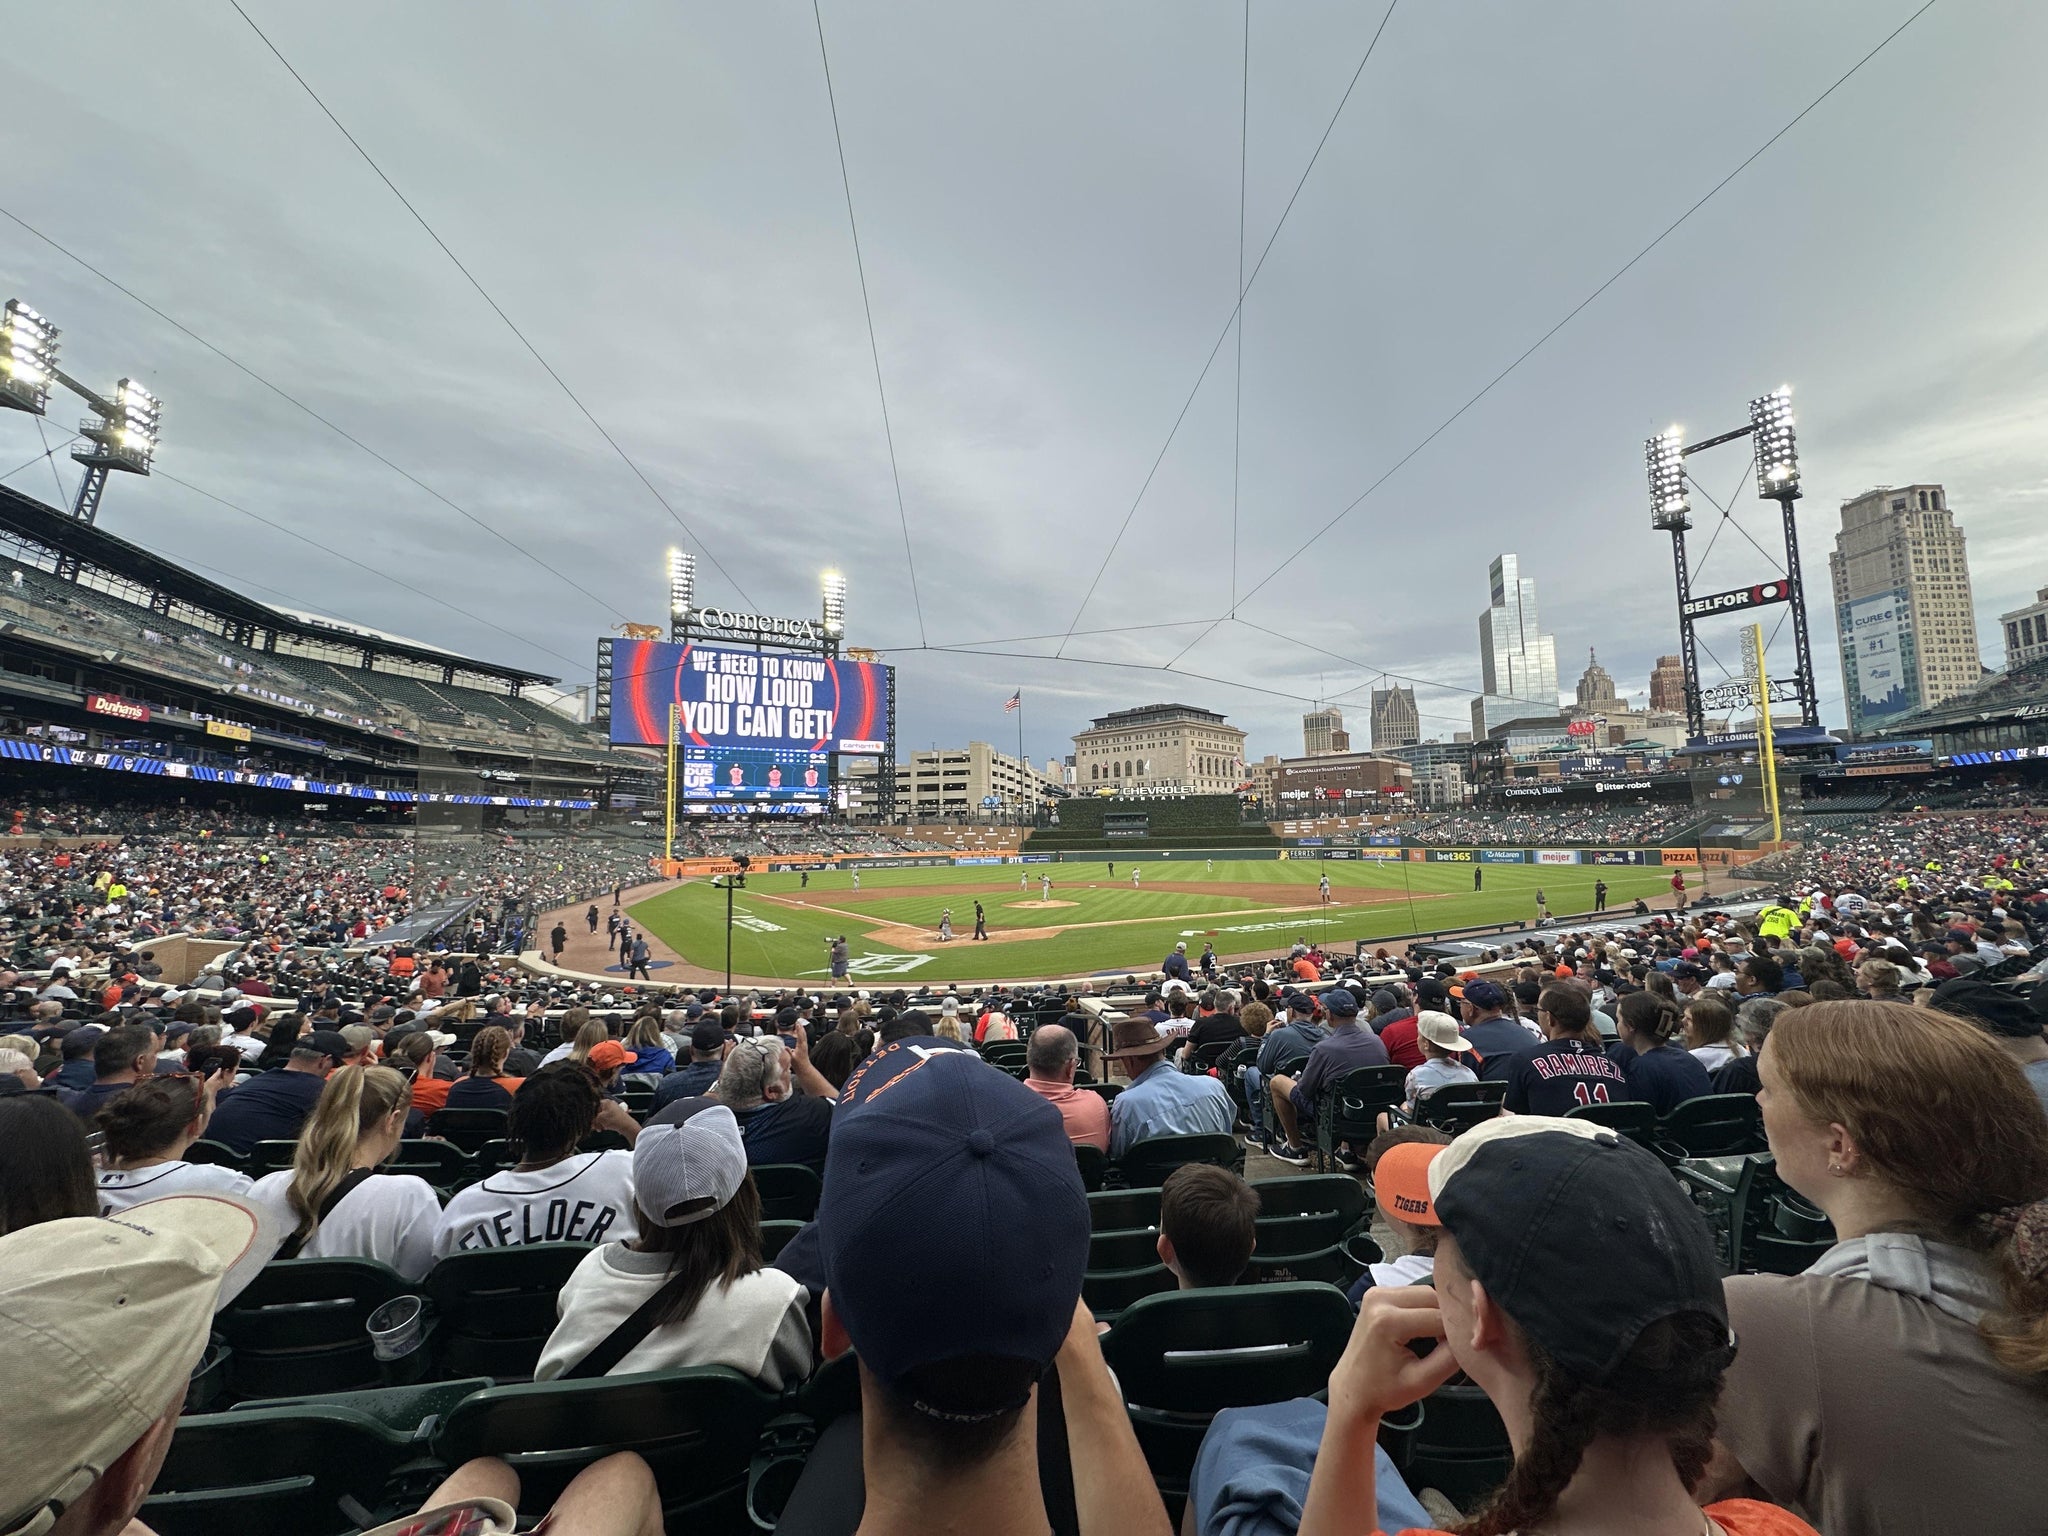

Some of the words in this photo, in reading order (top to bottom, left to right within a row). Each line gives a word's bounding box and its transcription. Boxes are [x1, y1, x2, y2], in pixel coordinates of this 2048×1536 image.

[1683, 592, 1748, 615] BELFOR
[700, 607, 817, 640] Comerica
[1855, 613, 1884, 625] CURE
[733, 629, 787, 643] PARK
[1869, 639, 1884, 651] #1
[692, 650, 717, 672] WE
[720, 653, 758, 675] NEED
[761, 656, 779, 677] TO
[783, 659, 825, 681] KNOW
[706, 673, 756, 704] HOW
[762, 677, 813, 708] LOUD
[1702, 680, 1780, 701] ComeriA
[95, 697, 143, 717] Dunham's
[682, 700, 729, 735] YOU
[736, 704, 782, 737] CAN
[789, 708, 833, 740] GET!
[673, 713, 681, 745] Rocket
[1569, 722, 1594, 733] AAA
[1706, 735, 1725, 745] Lite
[1725, 732, 1760, 741] LOUNGE
[42, 748, 51, 760] C
[1584, 757, 1602, 767] Lite
[685, 767, 713, 776] DUE
[684, 775, 713, 788] UP
[1604, 781, 1651, 791] litter-robot
[1122, 785, 1196, 795] CHEVROLET
[1281, 790, 1310, 800] meijer
[1542, 786, 1563, 794] Bank
[1437, 851, 1471, 861] bet365
[1542, 853, 1571, 862] meijer
[1600, 854, 1623, 863] Corona
[1664, 852, 1695, 862] PIZZA!
[1701, 852, 1729, 862] PIZZ!
[734, 865, 756, 873] PIZA!
[1848, 901, 1864, 910] 29
[1014, 1017, 1020, 1025] 2
[1022, 1028, 1027, 1036] 1
[1165, 1026, 1193, 1037] RAMIRE
[840, 1042, 901, 1105] DETROIT
[1532, 1053, 1626, 1084] RAMIREZ
[1573, 1081, 1611, 1106] 11
[1394, 1194, 1429, 1215] TIGERS
[459, 1199, 616, 1250] FIELDER
